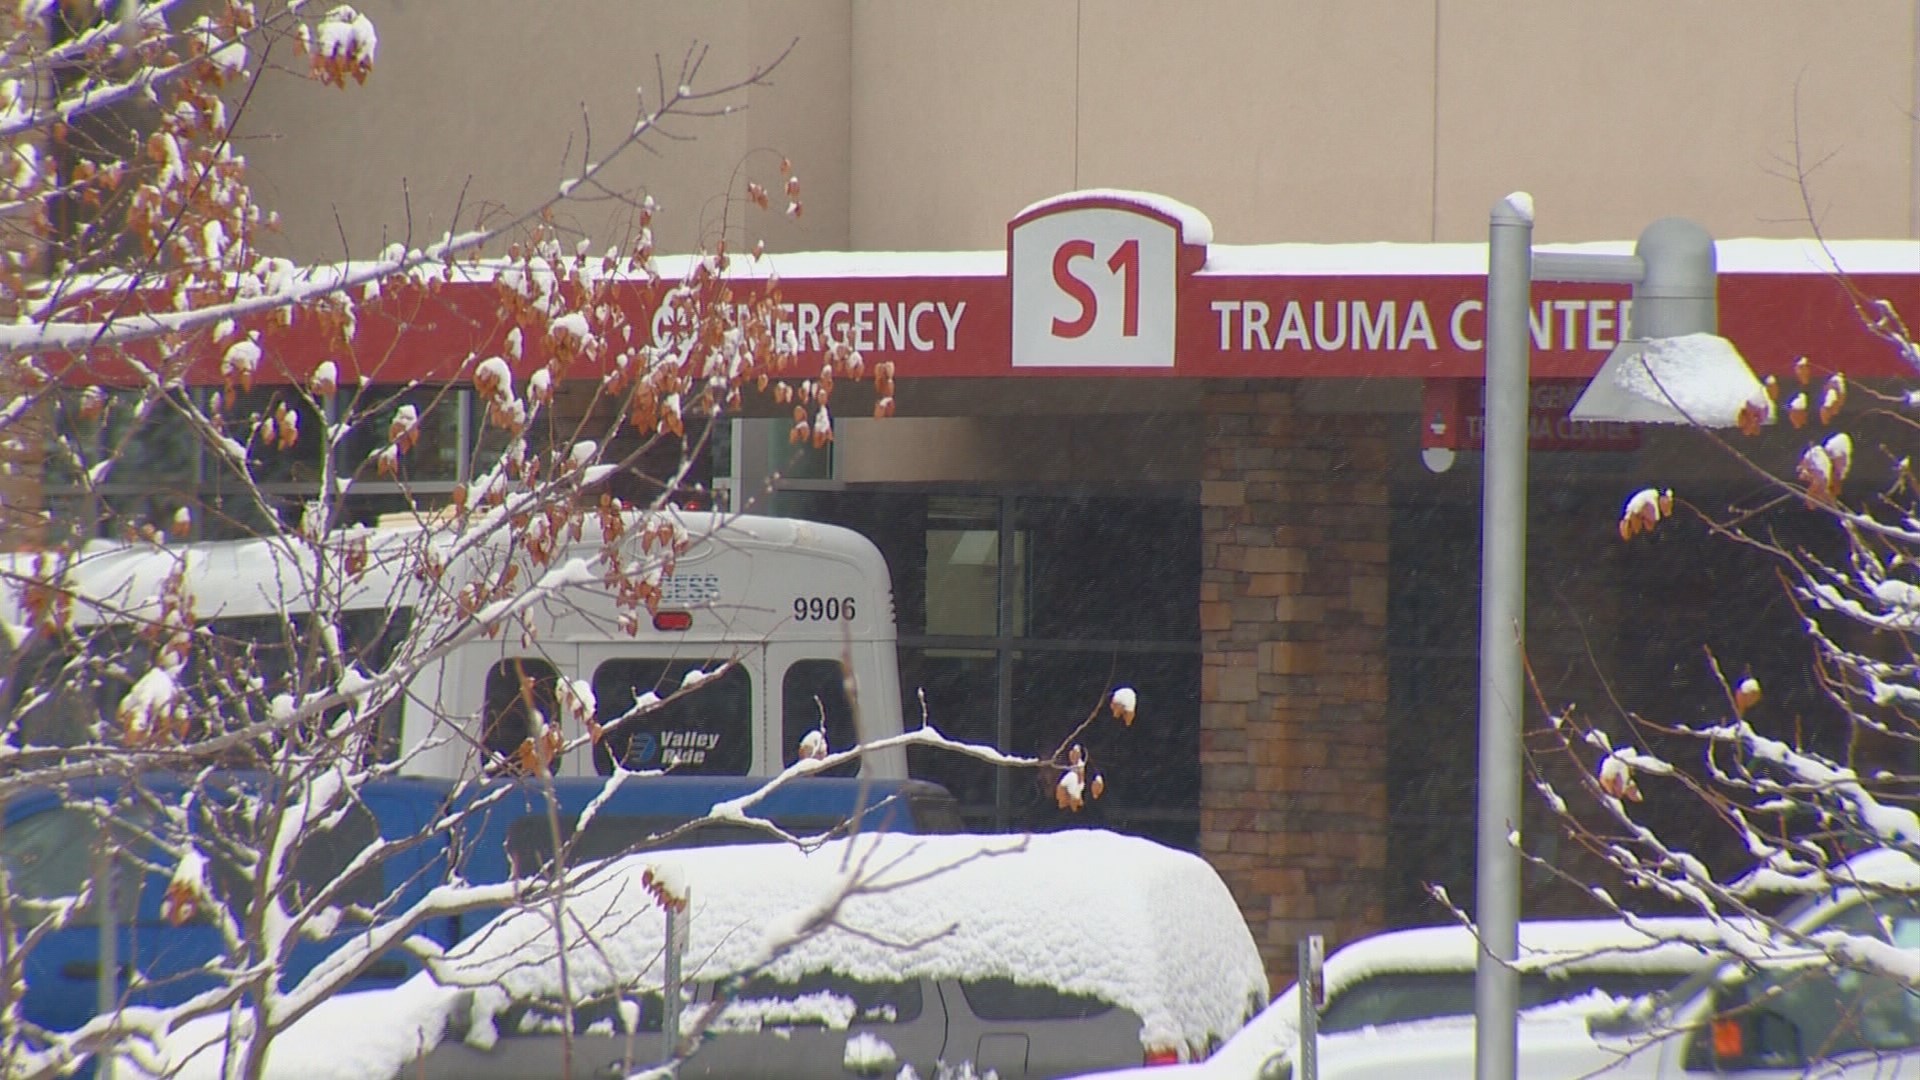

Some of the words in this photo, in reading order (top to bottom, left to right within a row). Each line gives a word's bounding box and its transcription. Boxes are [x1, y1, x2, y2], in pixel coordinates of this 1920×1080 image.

[1051, 239, 1139, 338] S1
[714, 301, 967, 351] ERGENCY
[1212, 301, 1437, 350] TRAUMA
[1450, 300, 1633, 351] CNTE
[794, 597, 856, 621] 9906
[661, 731, 720, 750] Valley
[661, 748, 706, 764] Ride
